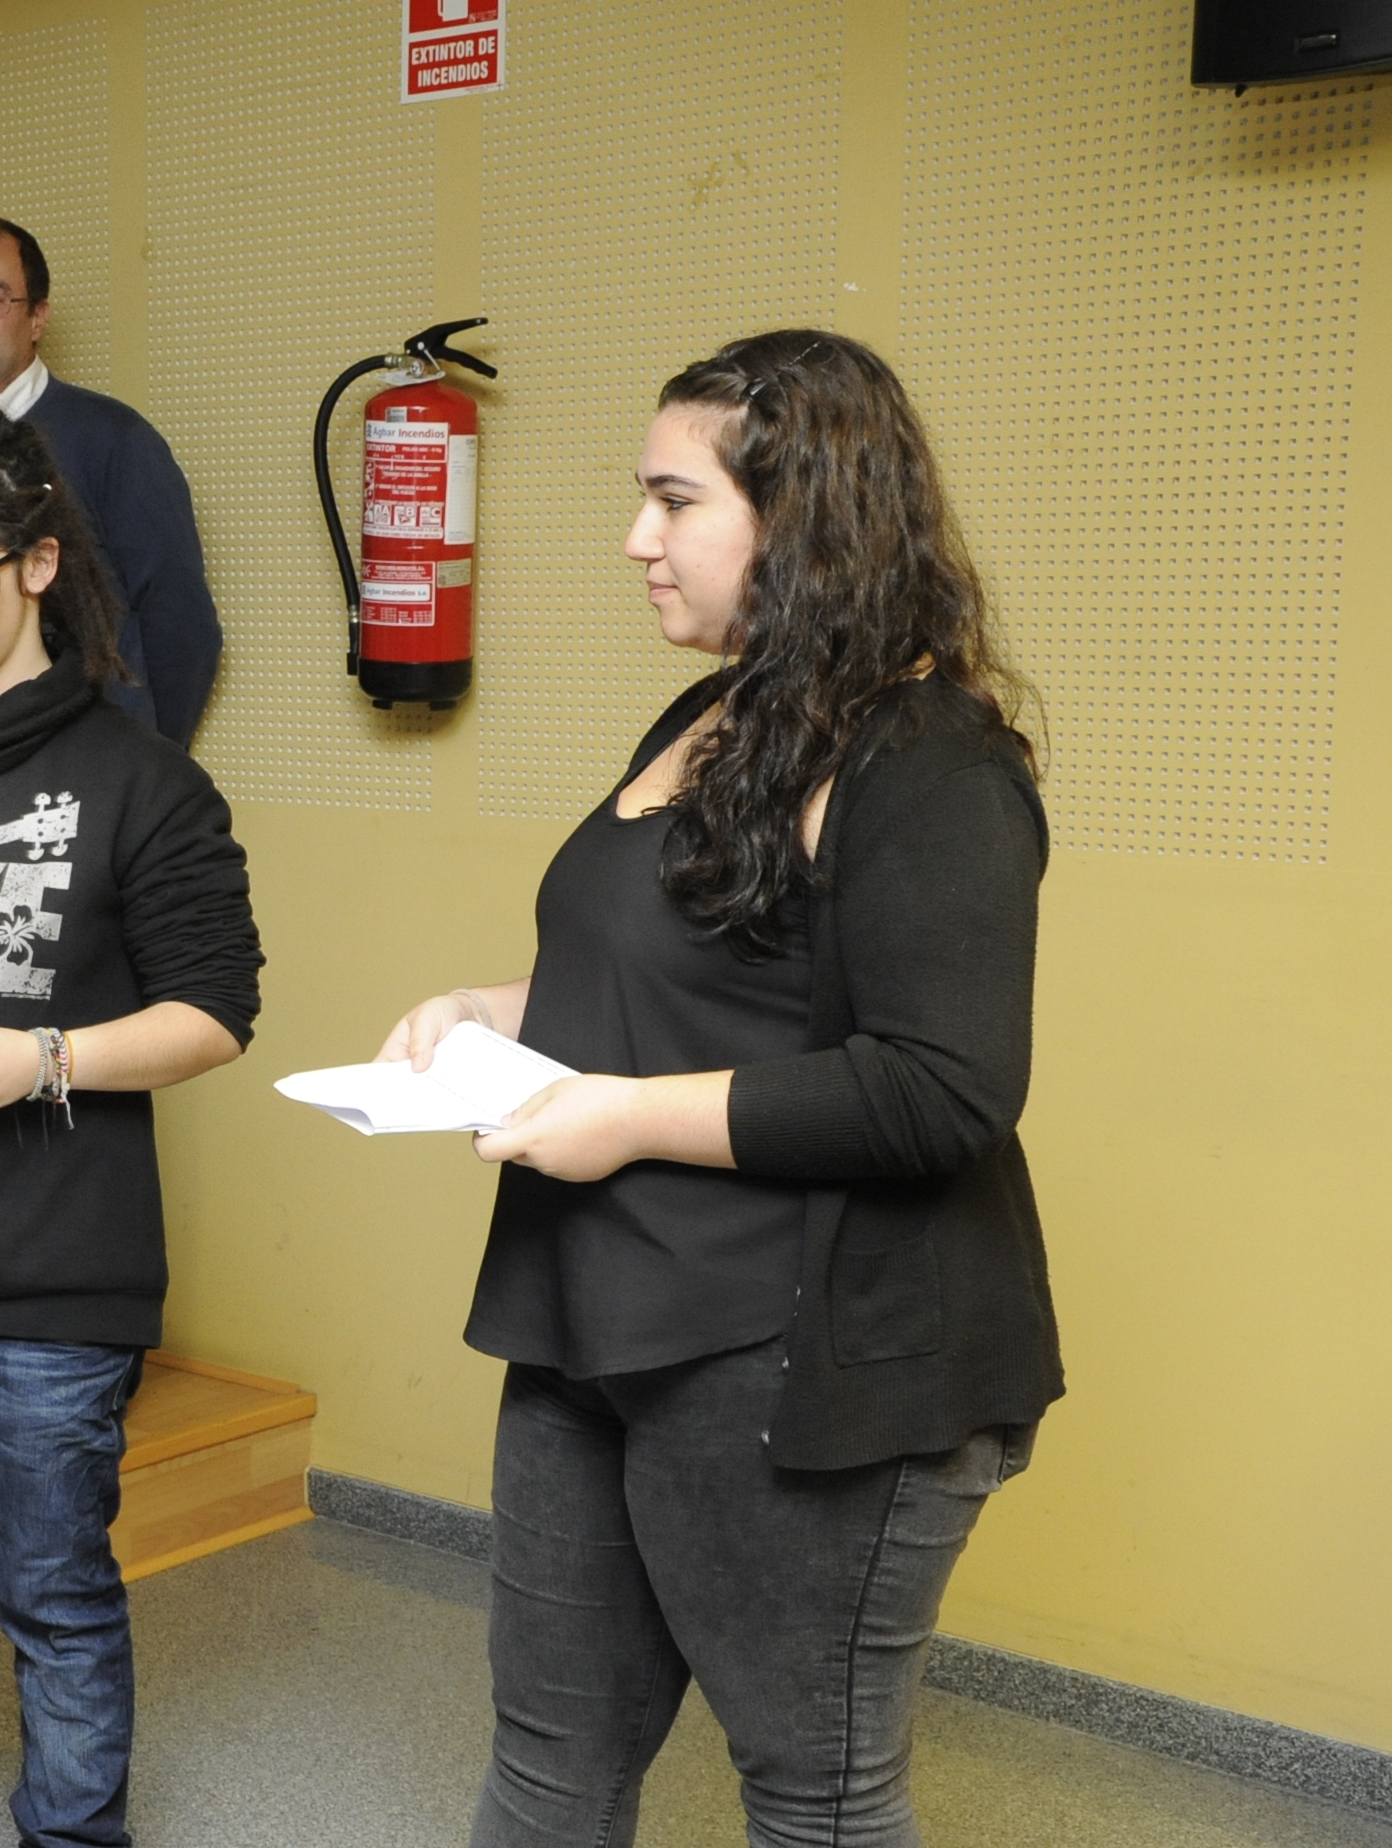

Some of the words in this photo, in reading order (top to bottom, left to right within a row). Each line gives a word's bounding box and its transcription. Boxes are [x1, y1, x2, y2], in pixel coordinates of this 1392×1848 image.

[411, 40, 474, 65] EXTINTOR
[478, 36, 496, 55] DE
[418, 61, 489, 87] INCENDIOS
[373, 427, 395, 438] Agbar
[398, 428, 445, 438] Incendios
[405, 507, 414, 517] B
[431, 507, 441, 518] C
